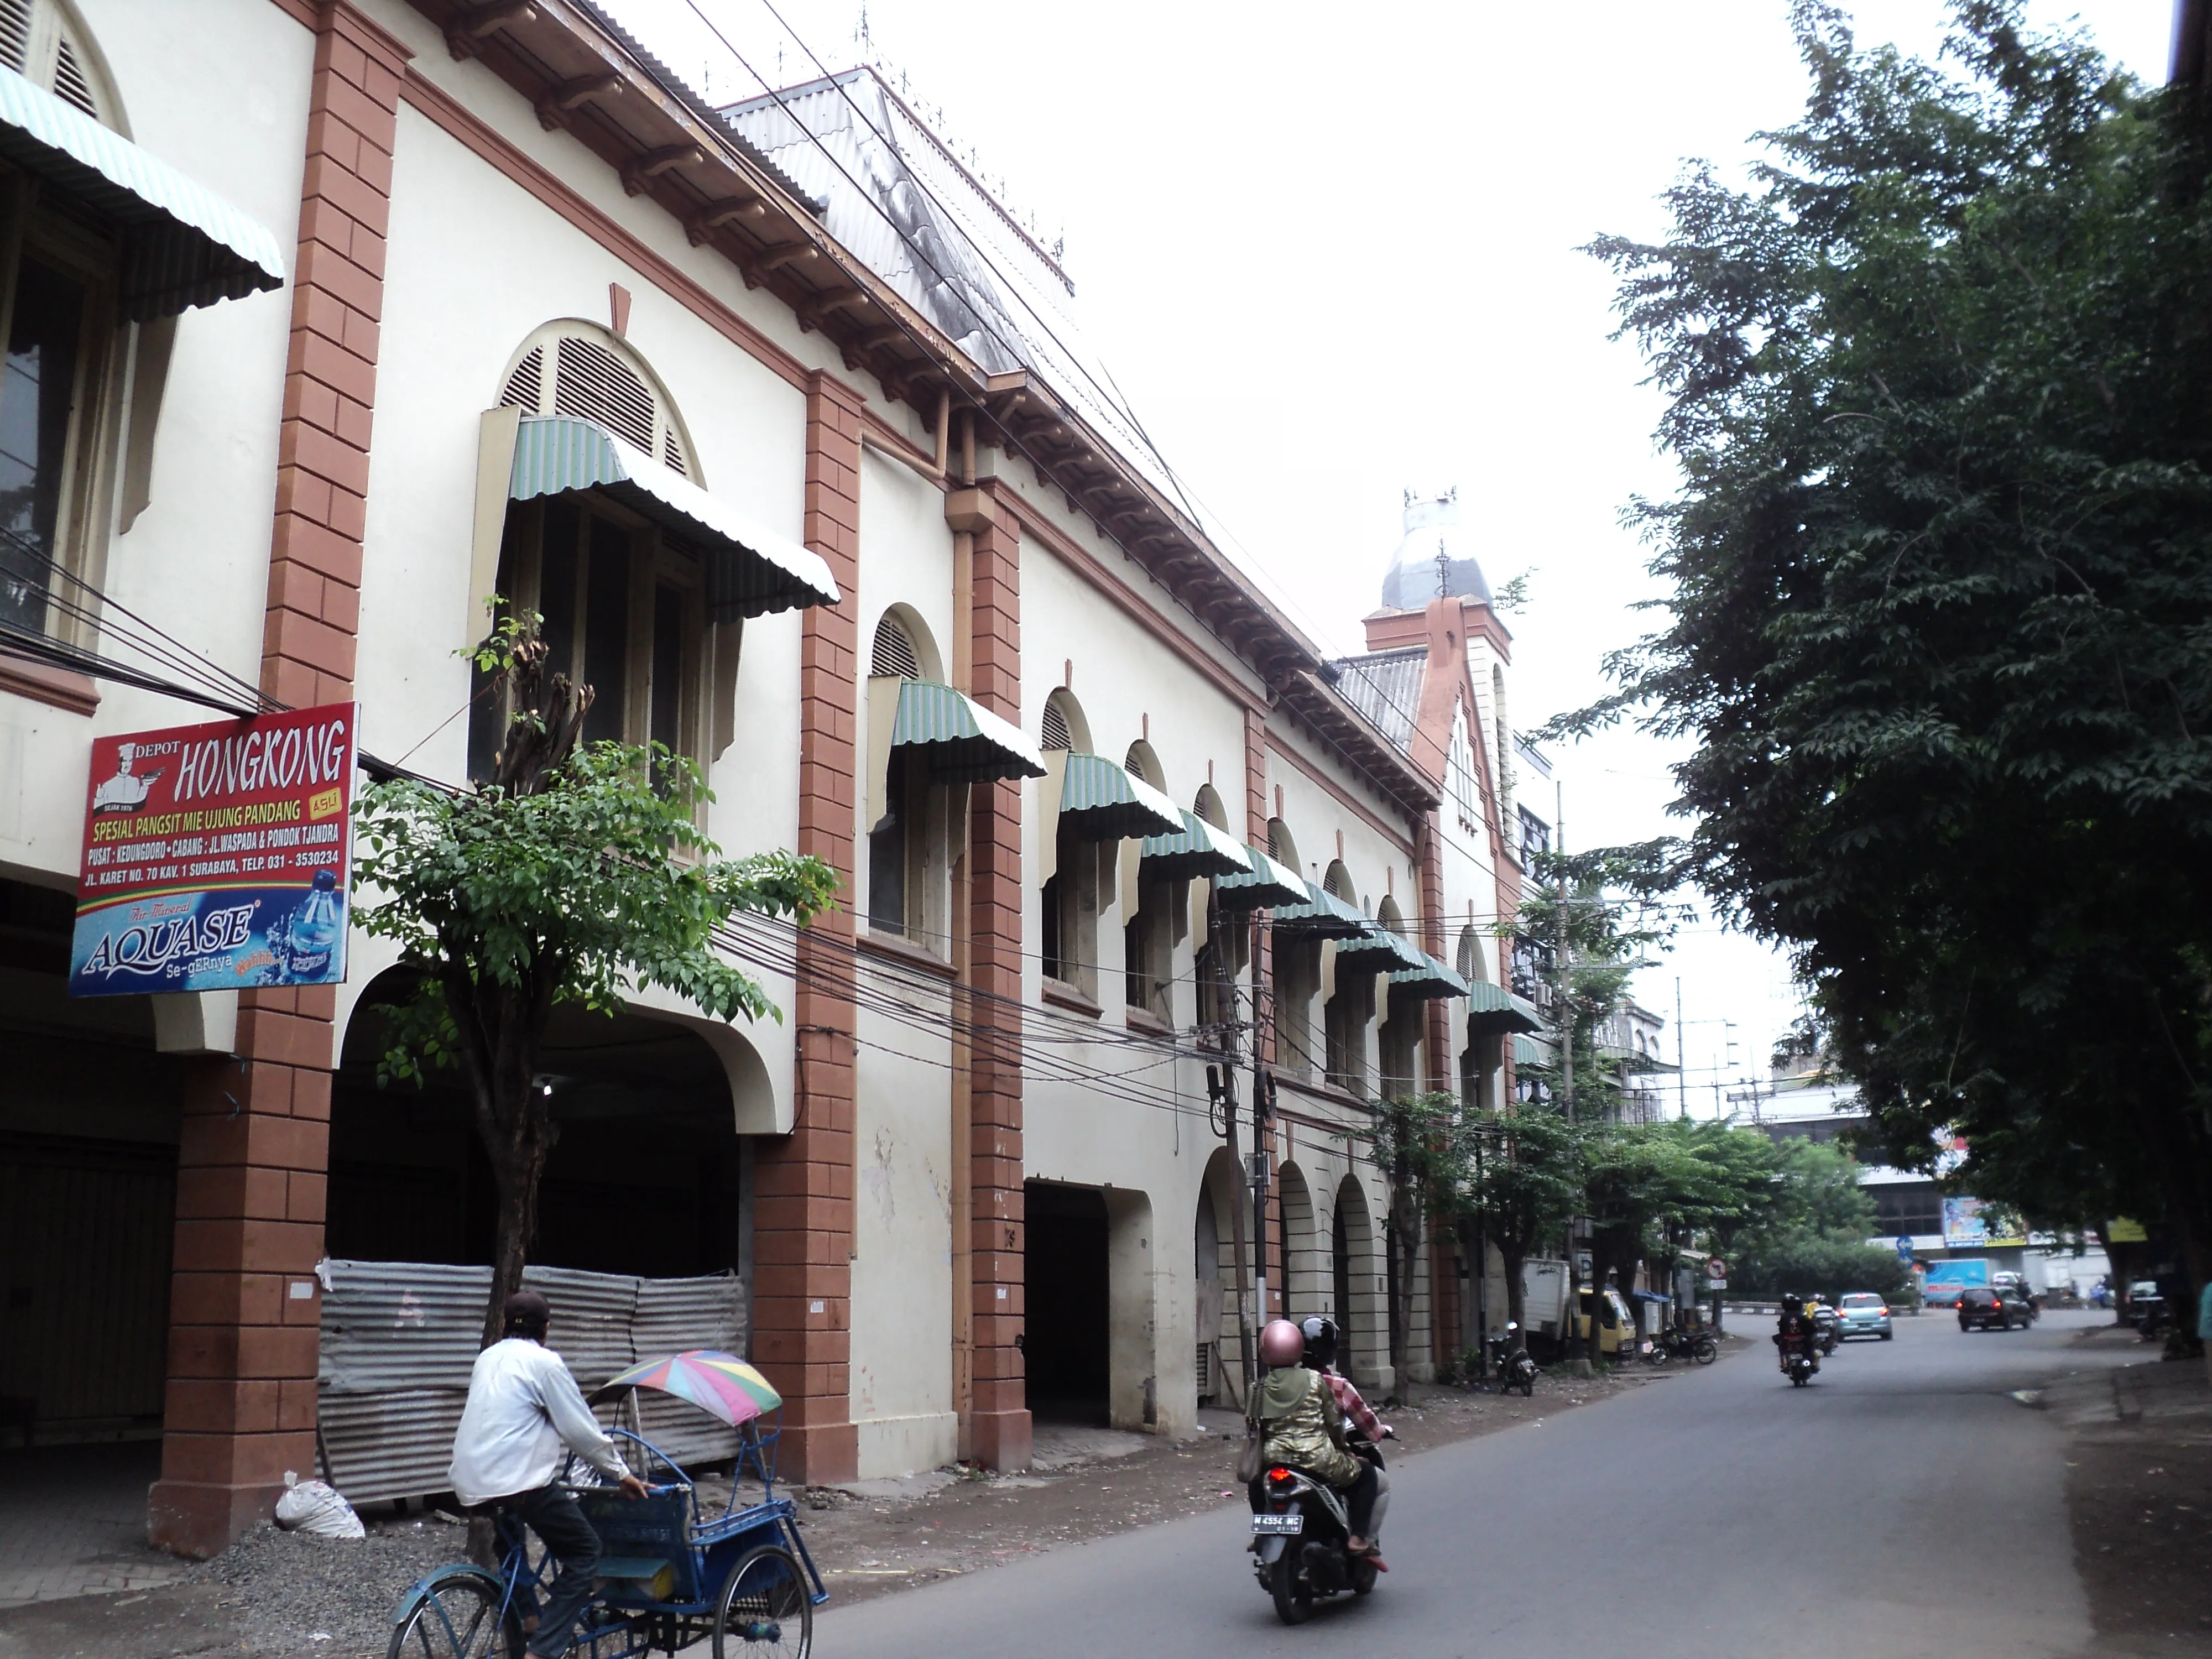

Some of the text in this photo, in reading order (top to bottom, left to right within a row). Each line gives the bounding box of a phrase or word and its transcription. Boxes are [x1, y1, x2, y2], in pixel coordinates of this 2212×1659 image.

[135, 719, 345, 802] DEPOT HONGKONG
[93, 820, 133, 843] SPESIAL
[183, 810, 204, 833] MIE
[205, 806, 242, 830] UJUNG
[244, 800, 301, 826] PANDANG
[104, 804, 120, 812] SEJAK
[88, 847, 112, 867] PUSAT
[259, 830, 265, 849] &
[267, 827, 301, 848] PONDOK
[302, 823, 338, 844] TJANDRA
[85, 873, 97, 887] JL.
[100, 870, 127, 885] KARET
[129, 868, 144, 882] NO.
[147, 866, 158, 880] 70
[160, 865, 179, 879] KAV.
[181, 864, 187, 877] 1
[190, 859, 239, 877] SURABAYA,
[242, 857, 265, 872] TELP.
[267, 855, 285, 869] 031
[295, 849, 338, 867] 3530234
[130, 898, 193, 921] Air Mineral
[82, 904, 254, 980] AQUASE
